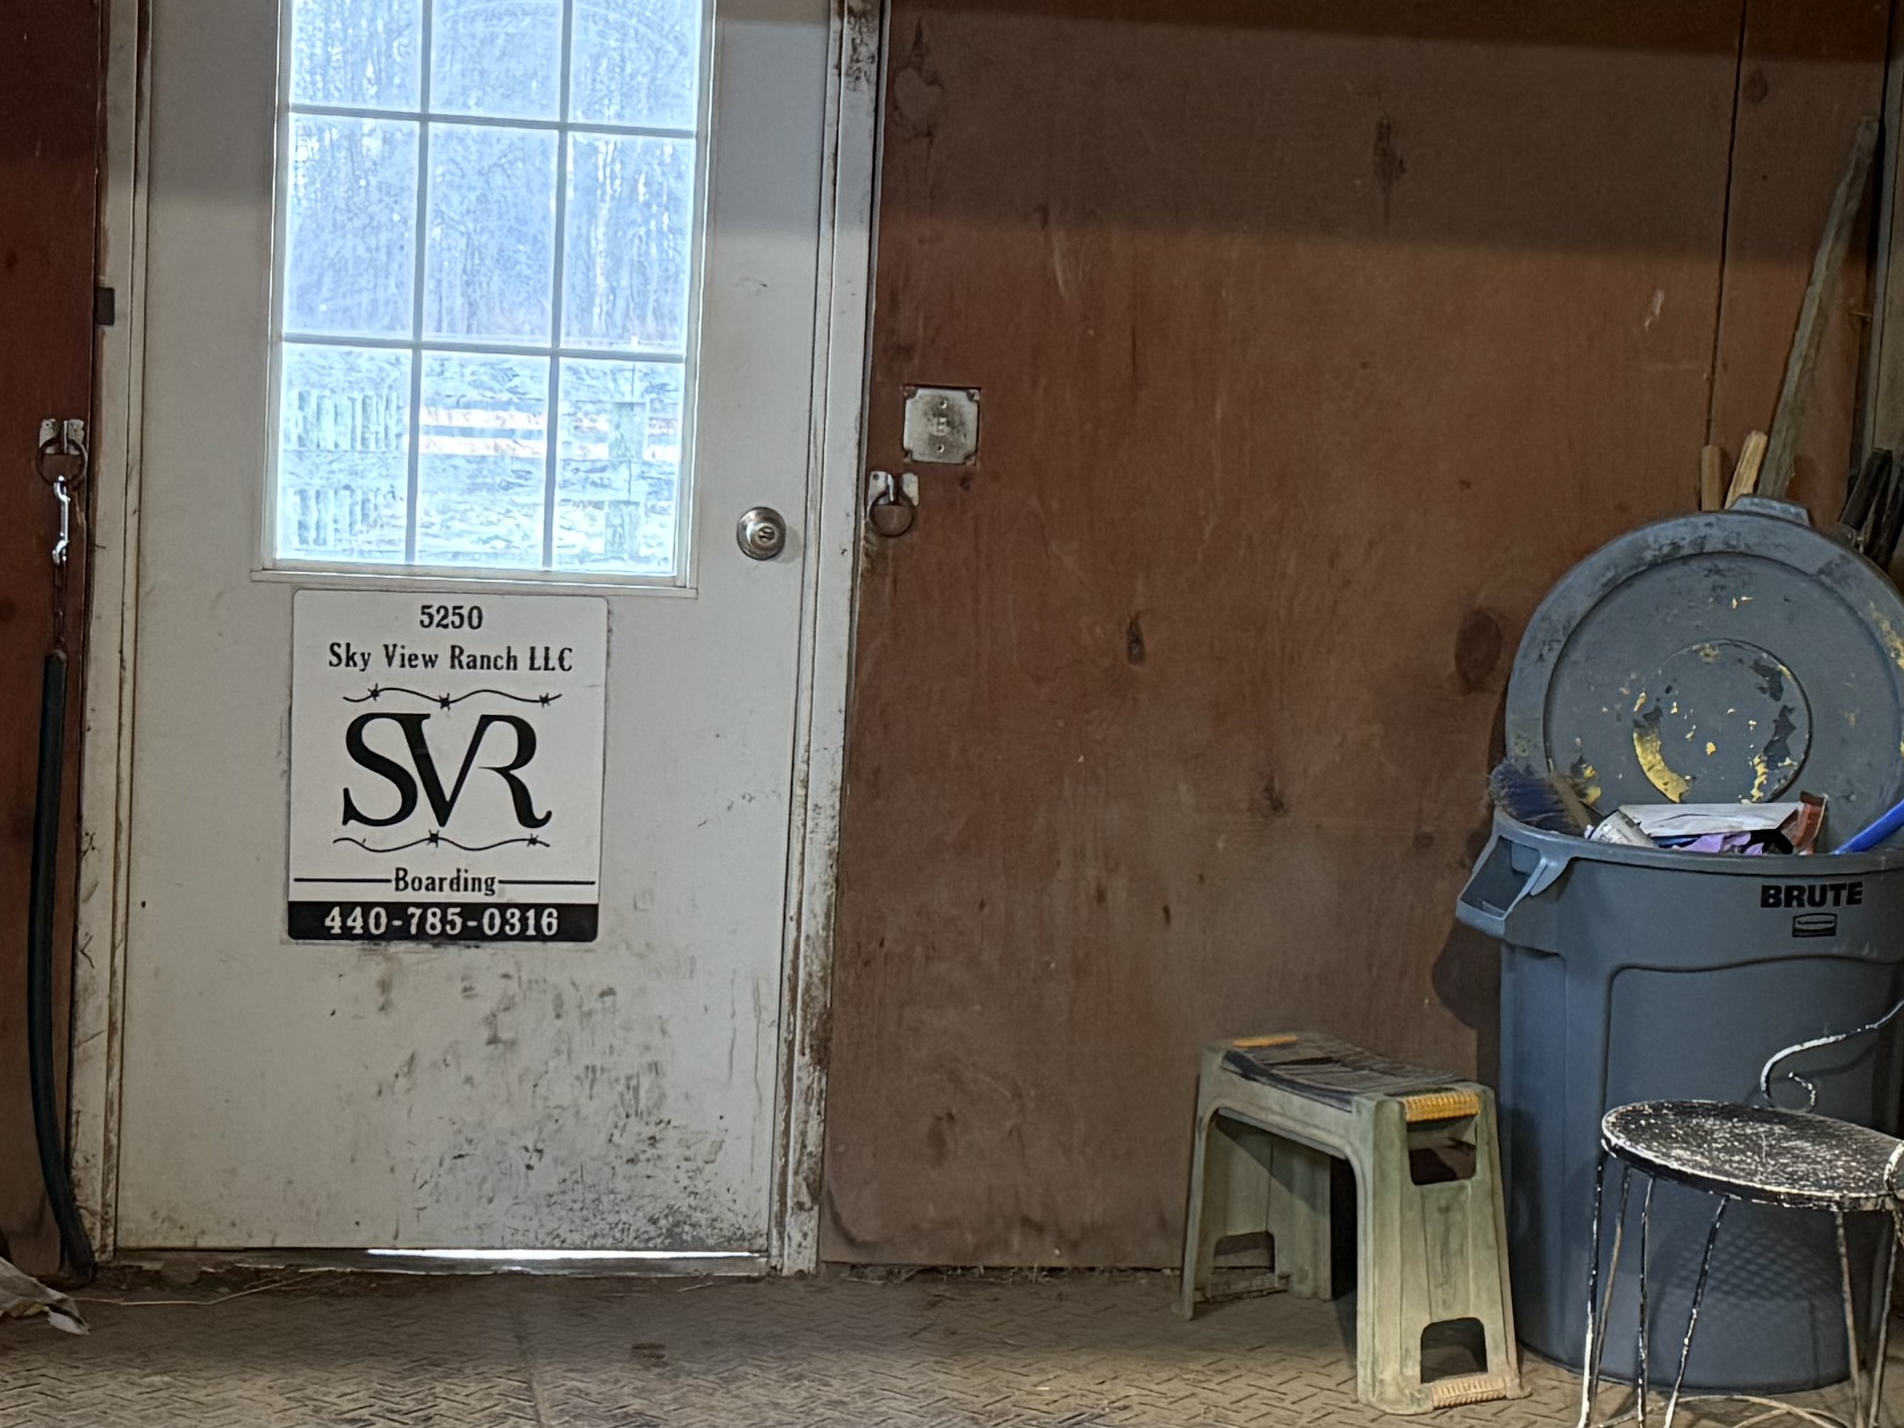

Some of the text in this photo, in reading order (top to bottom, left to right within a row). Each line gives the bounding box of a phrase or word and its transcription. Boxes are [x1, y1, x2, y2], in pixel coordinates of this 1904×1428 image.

[419, 604, 483, 630] 5250
[328, 642, 572, 672] Sky View Ranch LLC
[342, 712, 552, 829] SVR
[394, 867, 497, 897] Boarding
[1760, 881, 1863, 909] BRUTE
[324, 906, 559, 936] 440-785-0316
